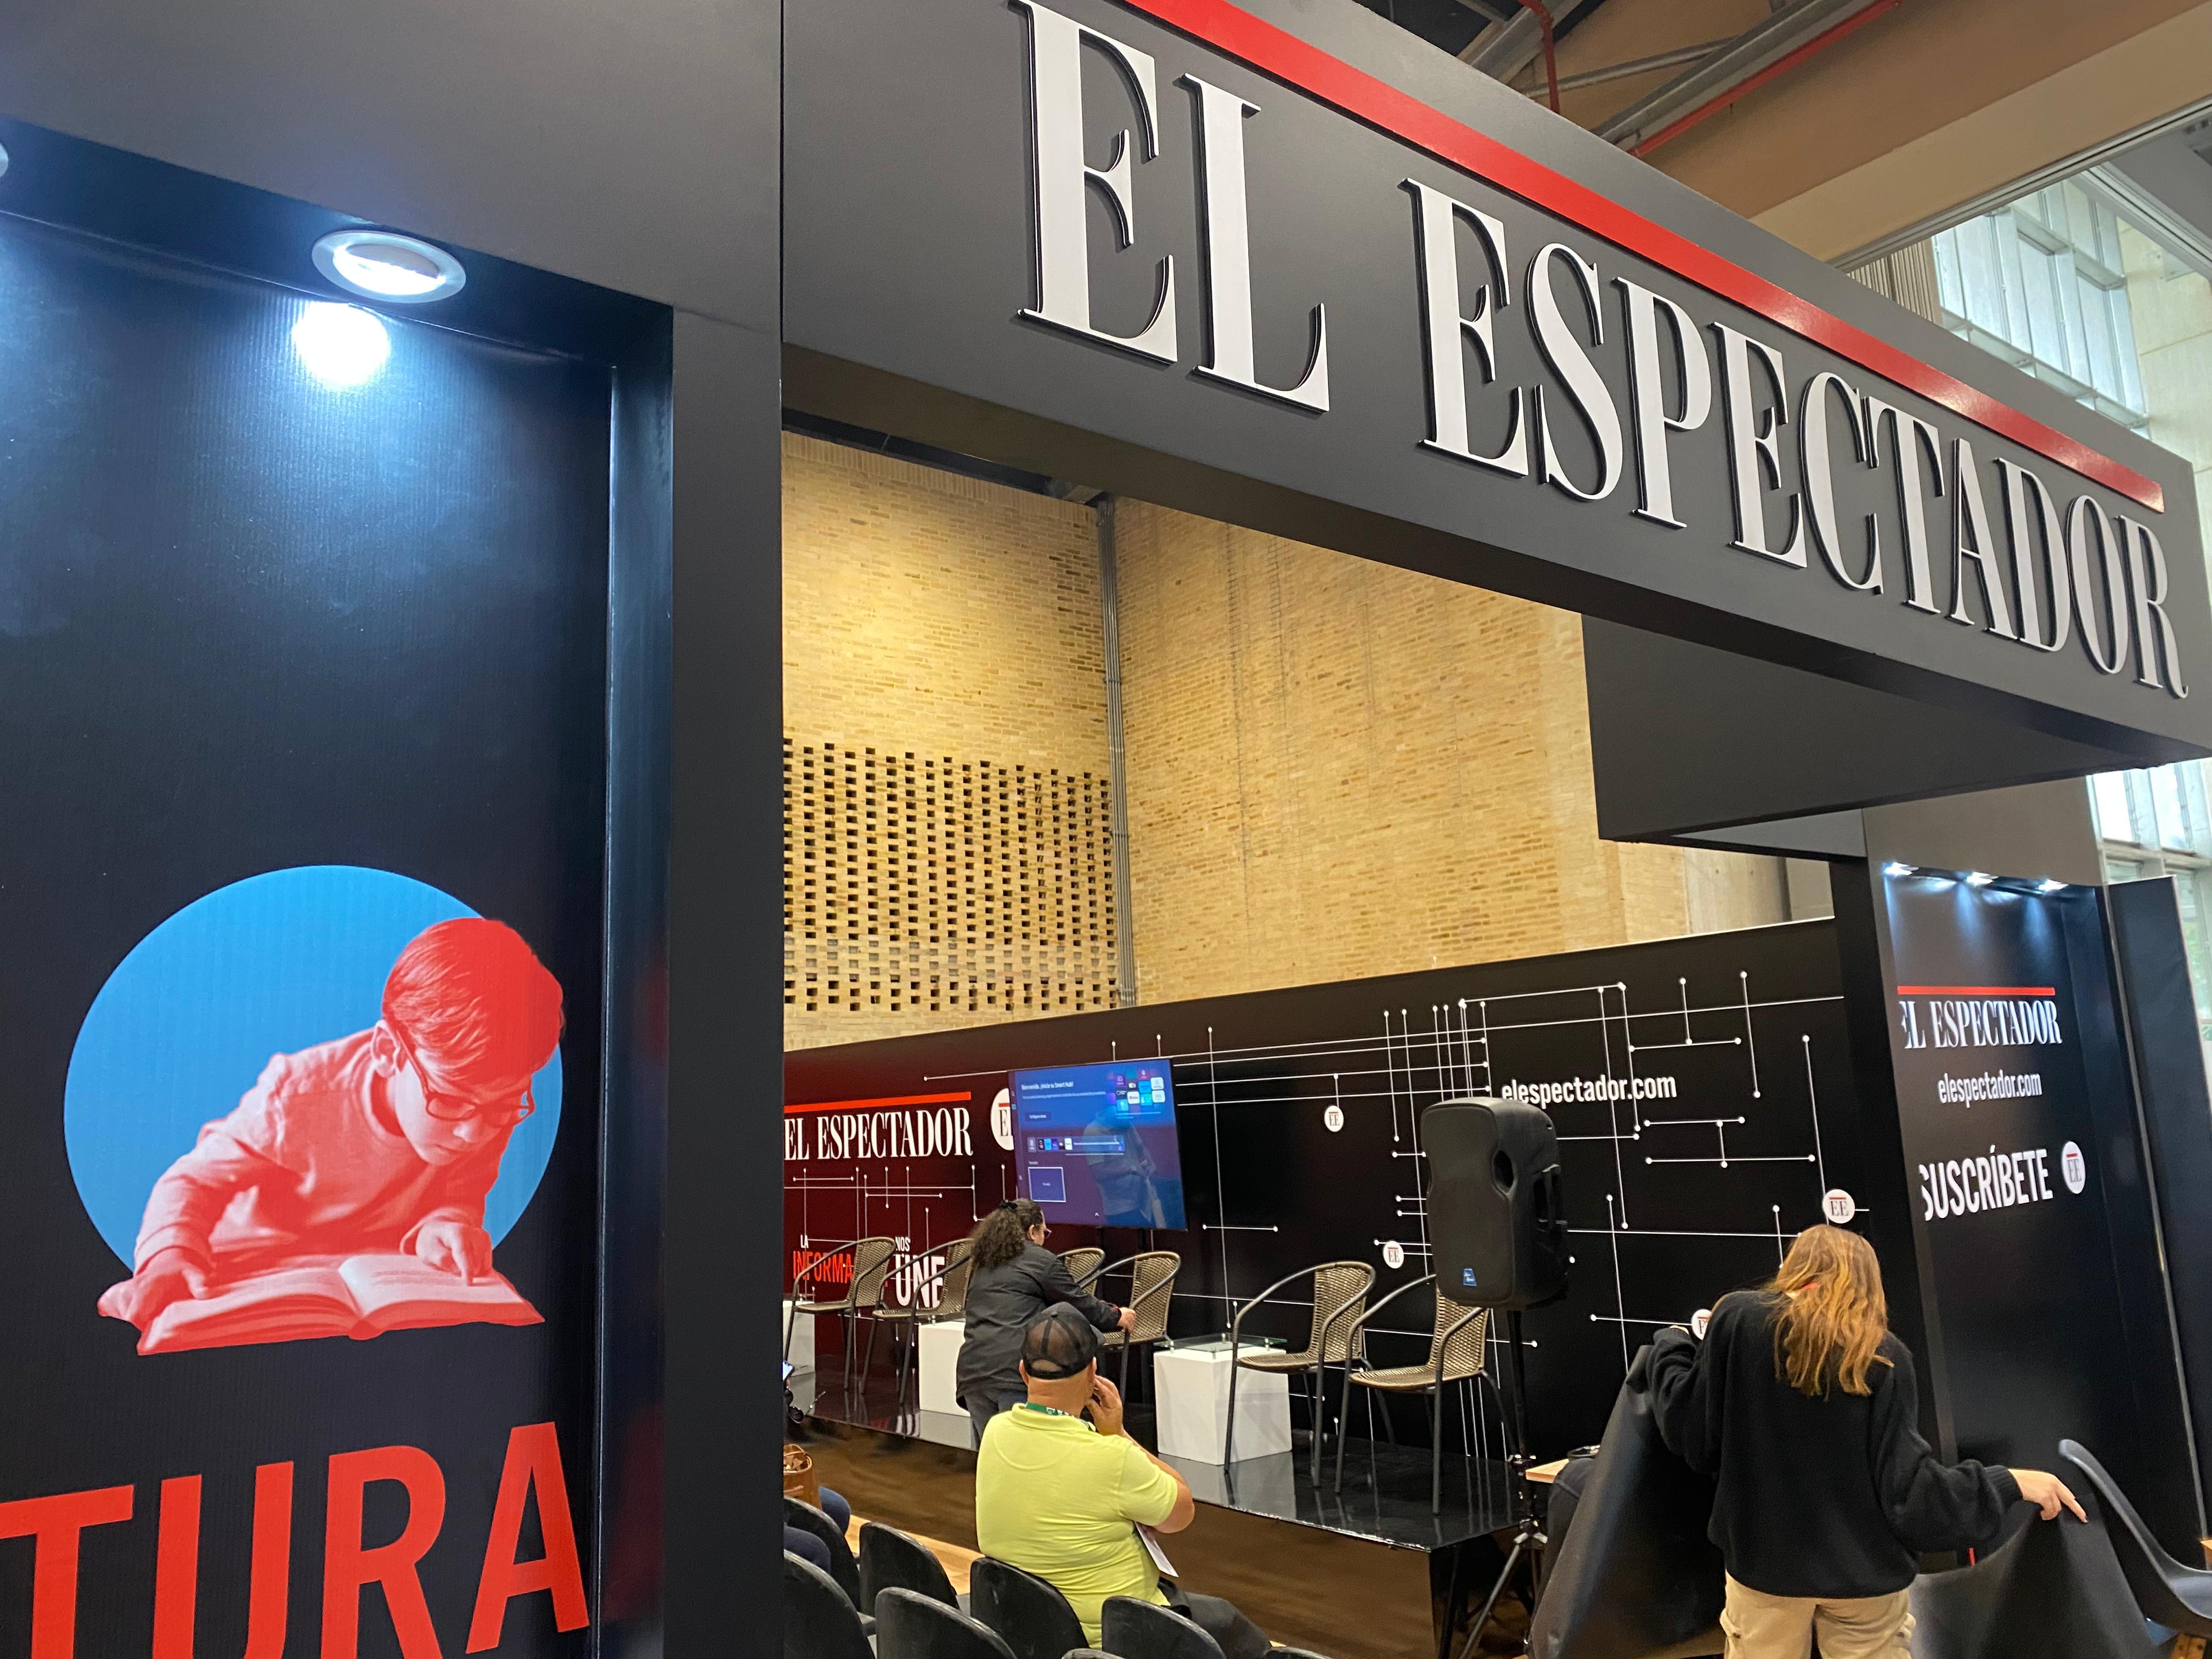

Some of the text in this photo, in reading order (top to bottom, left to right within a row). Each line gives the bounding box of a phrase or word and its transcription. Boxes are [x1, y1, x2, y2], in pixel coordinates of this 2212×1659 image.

[1009, 0, 2189, 699] EL ESPECTADOR
[1929, 1000, 2063, 1048] ESPECTADOR
[1502, 1074, 1678, 1110] elespectador.com
[1937, 1069, 2042, 1109] elespectador.com
[784, 1107, 974, 1160] EL ESPECTADOR
[1918, 1145, 2053, 1221] SUSCRÍBETE
[2067, 1158, 2082, 1183] EE
[1830, 1200, 1849, 1216] EE
[800, 1234, 809, 1249] LA
[895, 1236, 911, 1252] NOS
[793, 1250, 854, 1284] INFORMA
[895, 1254, 945, 1310] UNE
[0, 1421, 589, 1659] TURA
